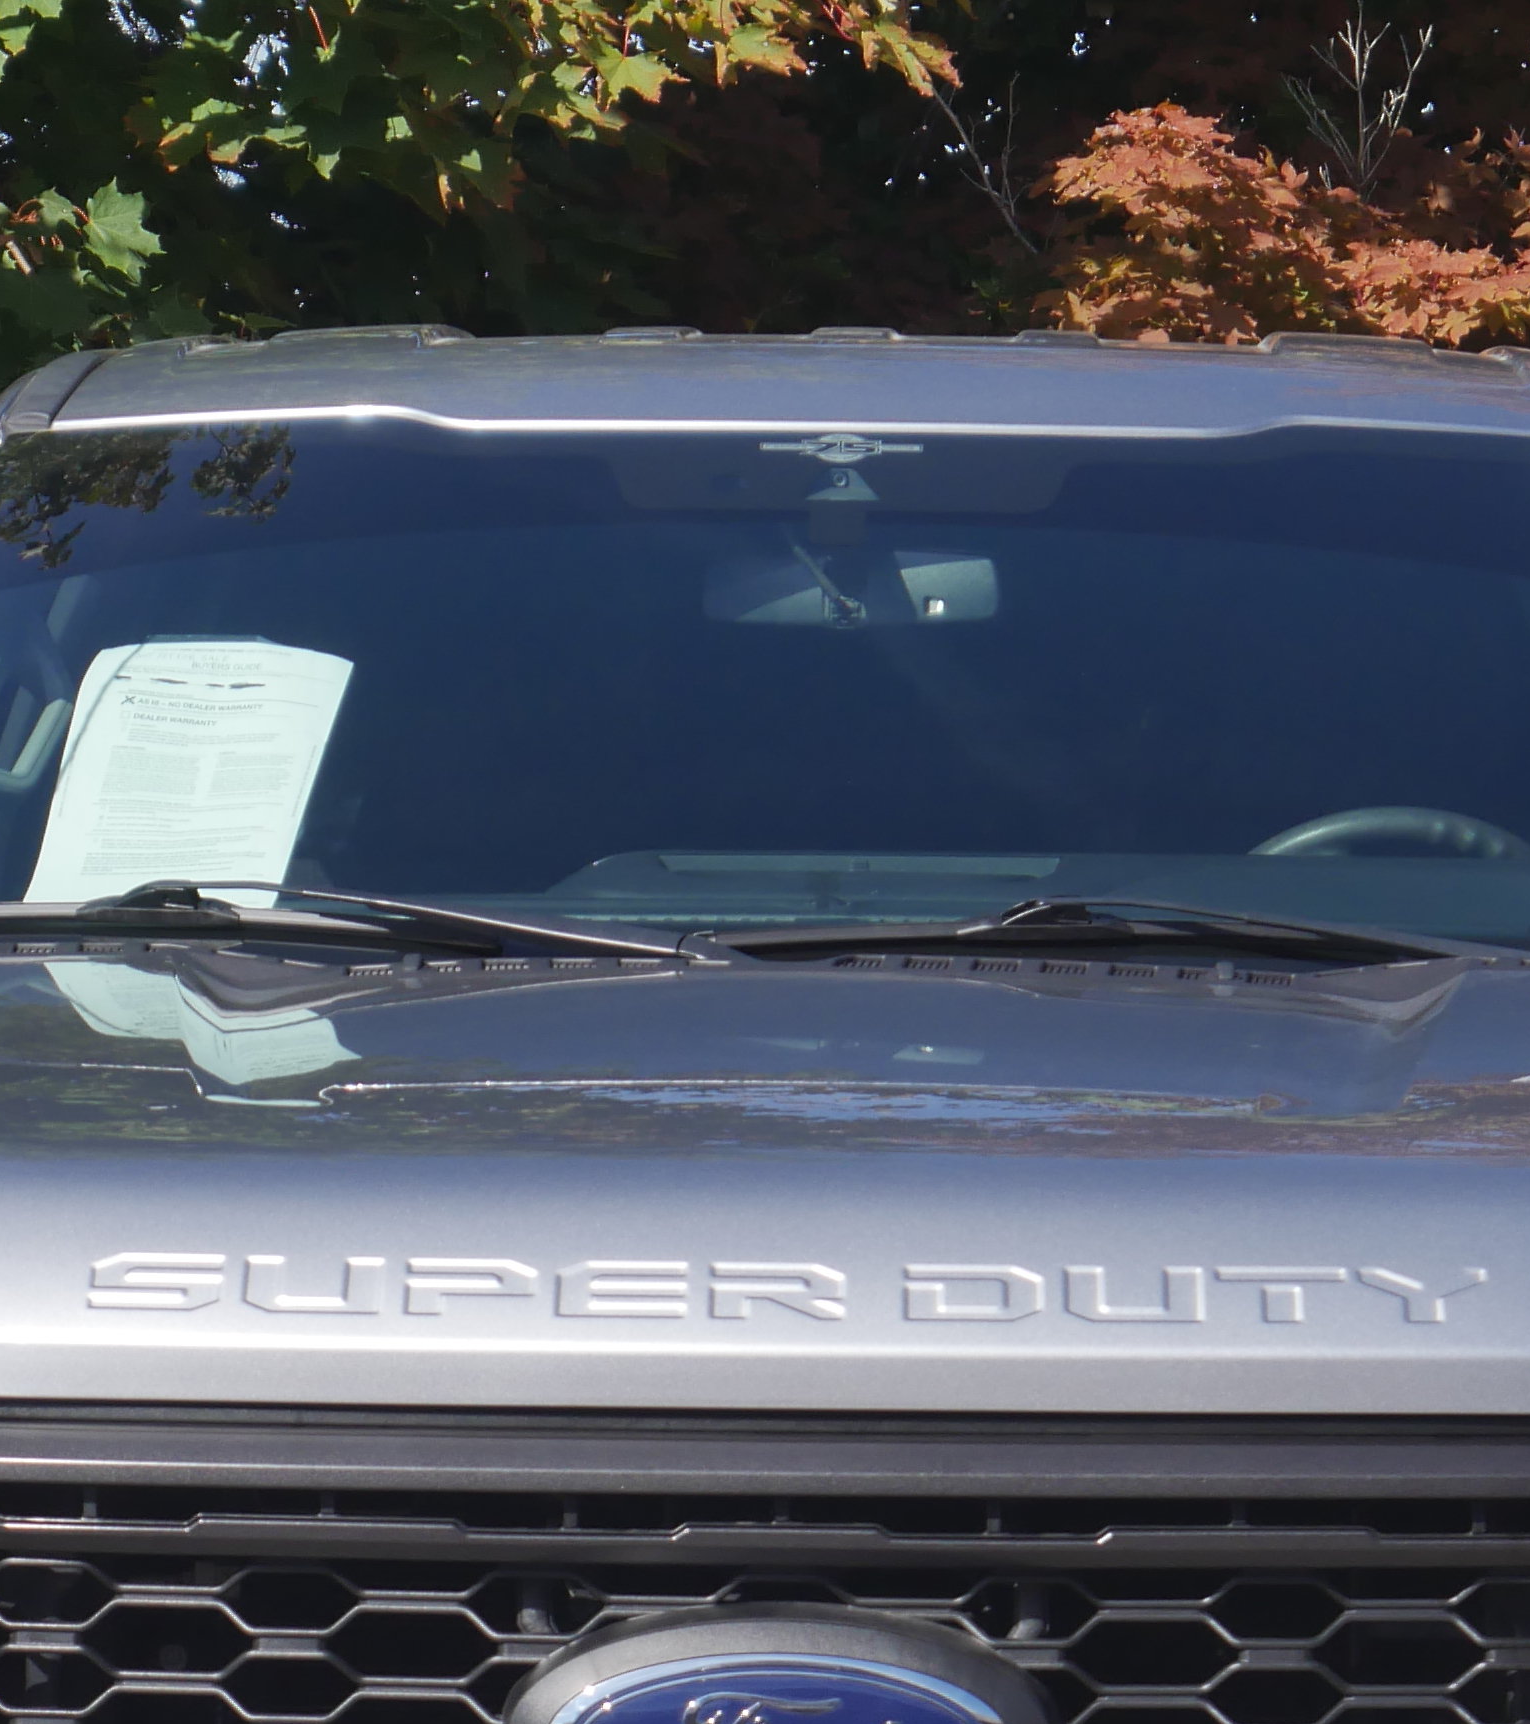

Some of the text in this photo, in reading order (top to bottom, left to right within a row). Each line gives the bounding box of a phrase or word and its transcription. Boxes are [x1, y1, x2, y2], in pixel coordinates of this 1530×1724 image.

[182, 701, 217, 711] DEALER
[218, 703, 264, 712] WARRANTY
[133, 711, 218, 727] DEALER WARRANTY
[85, 1250, 1489, 1323] SUPER DUTY
